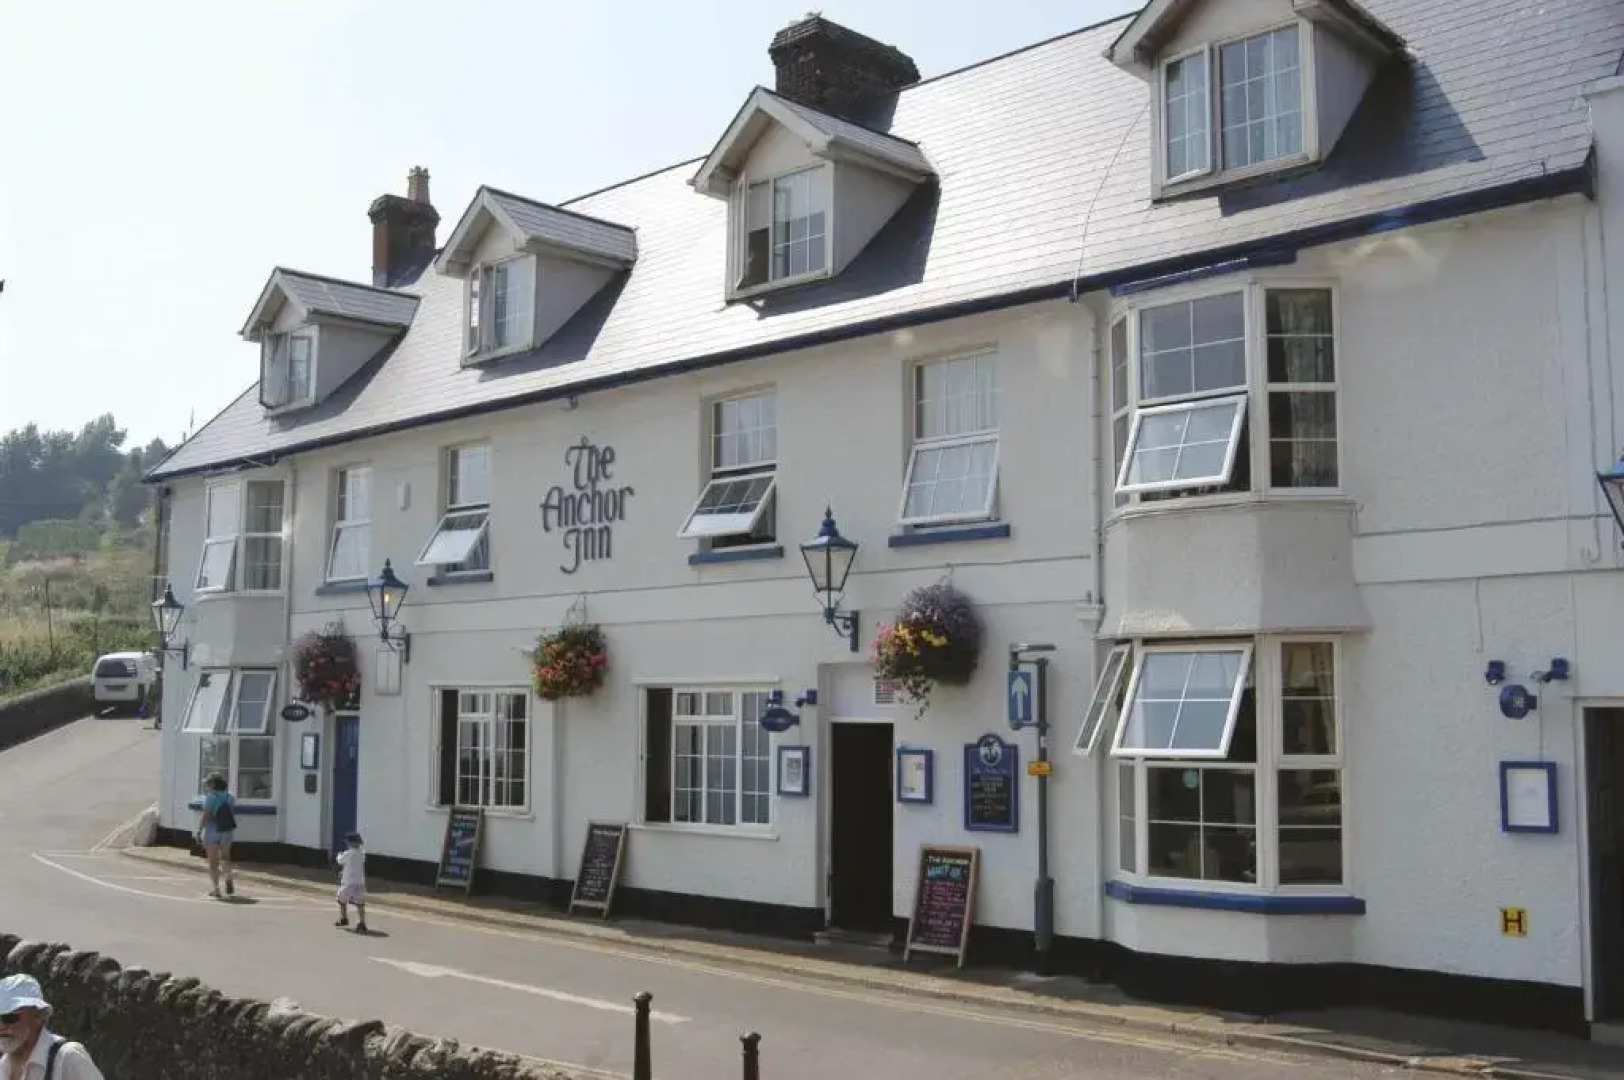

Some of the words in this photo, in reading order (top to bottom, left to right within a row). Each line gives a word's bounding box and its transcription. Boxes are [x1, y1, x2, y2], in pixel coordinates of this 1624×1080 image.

[565, 436, 615, 490] The
[539, 485, 634, 532] Anchor
[560, 525, 612, 574] Inn
[1503, 908, 1523, 932] H
